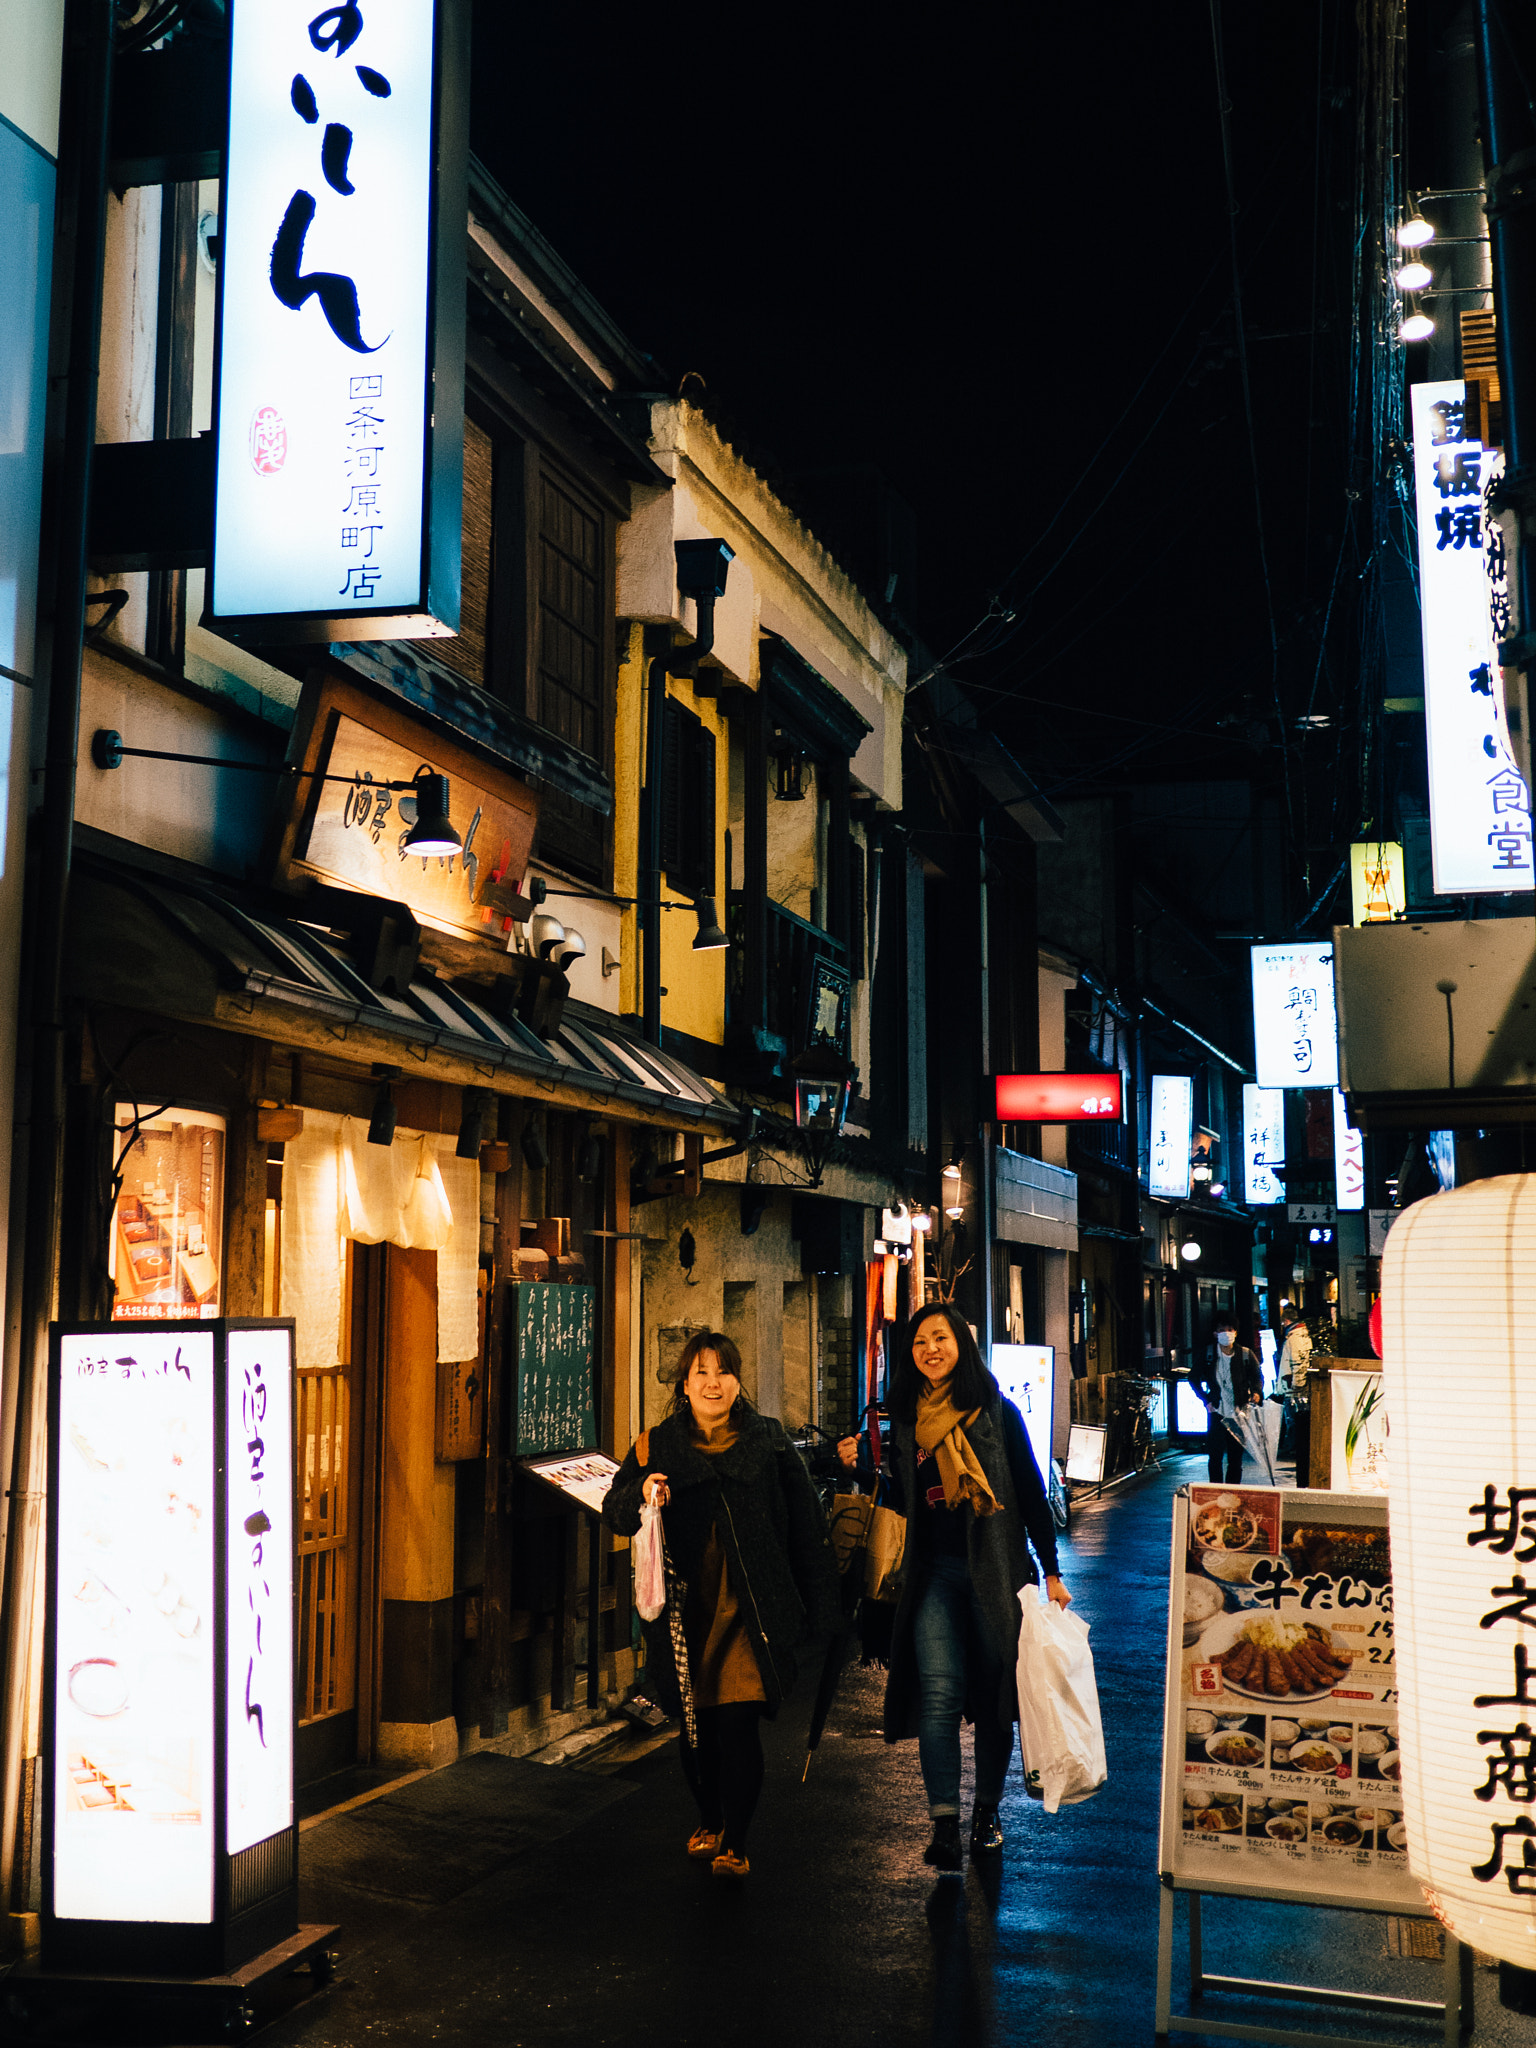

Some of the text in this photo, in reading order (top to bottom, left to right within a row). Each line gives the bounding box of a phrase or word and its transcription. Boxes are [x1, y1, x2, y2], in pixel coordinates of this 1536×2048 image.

[338, 375, 385, 599] 四条河原町店
[1270, 1773, 1338, 1788] 牛たんサラダ定食
[1467, 1482, 1536, 1898] 坂之上商店
